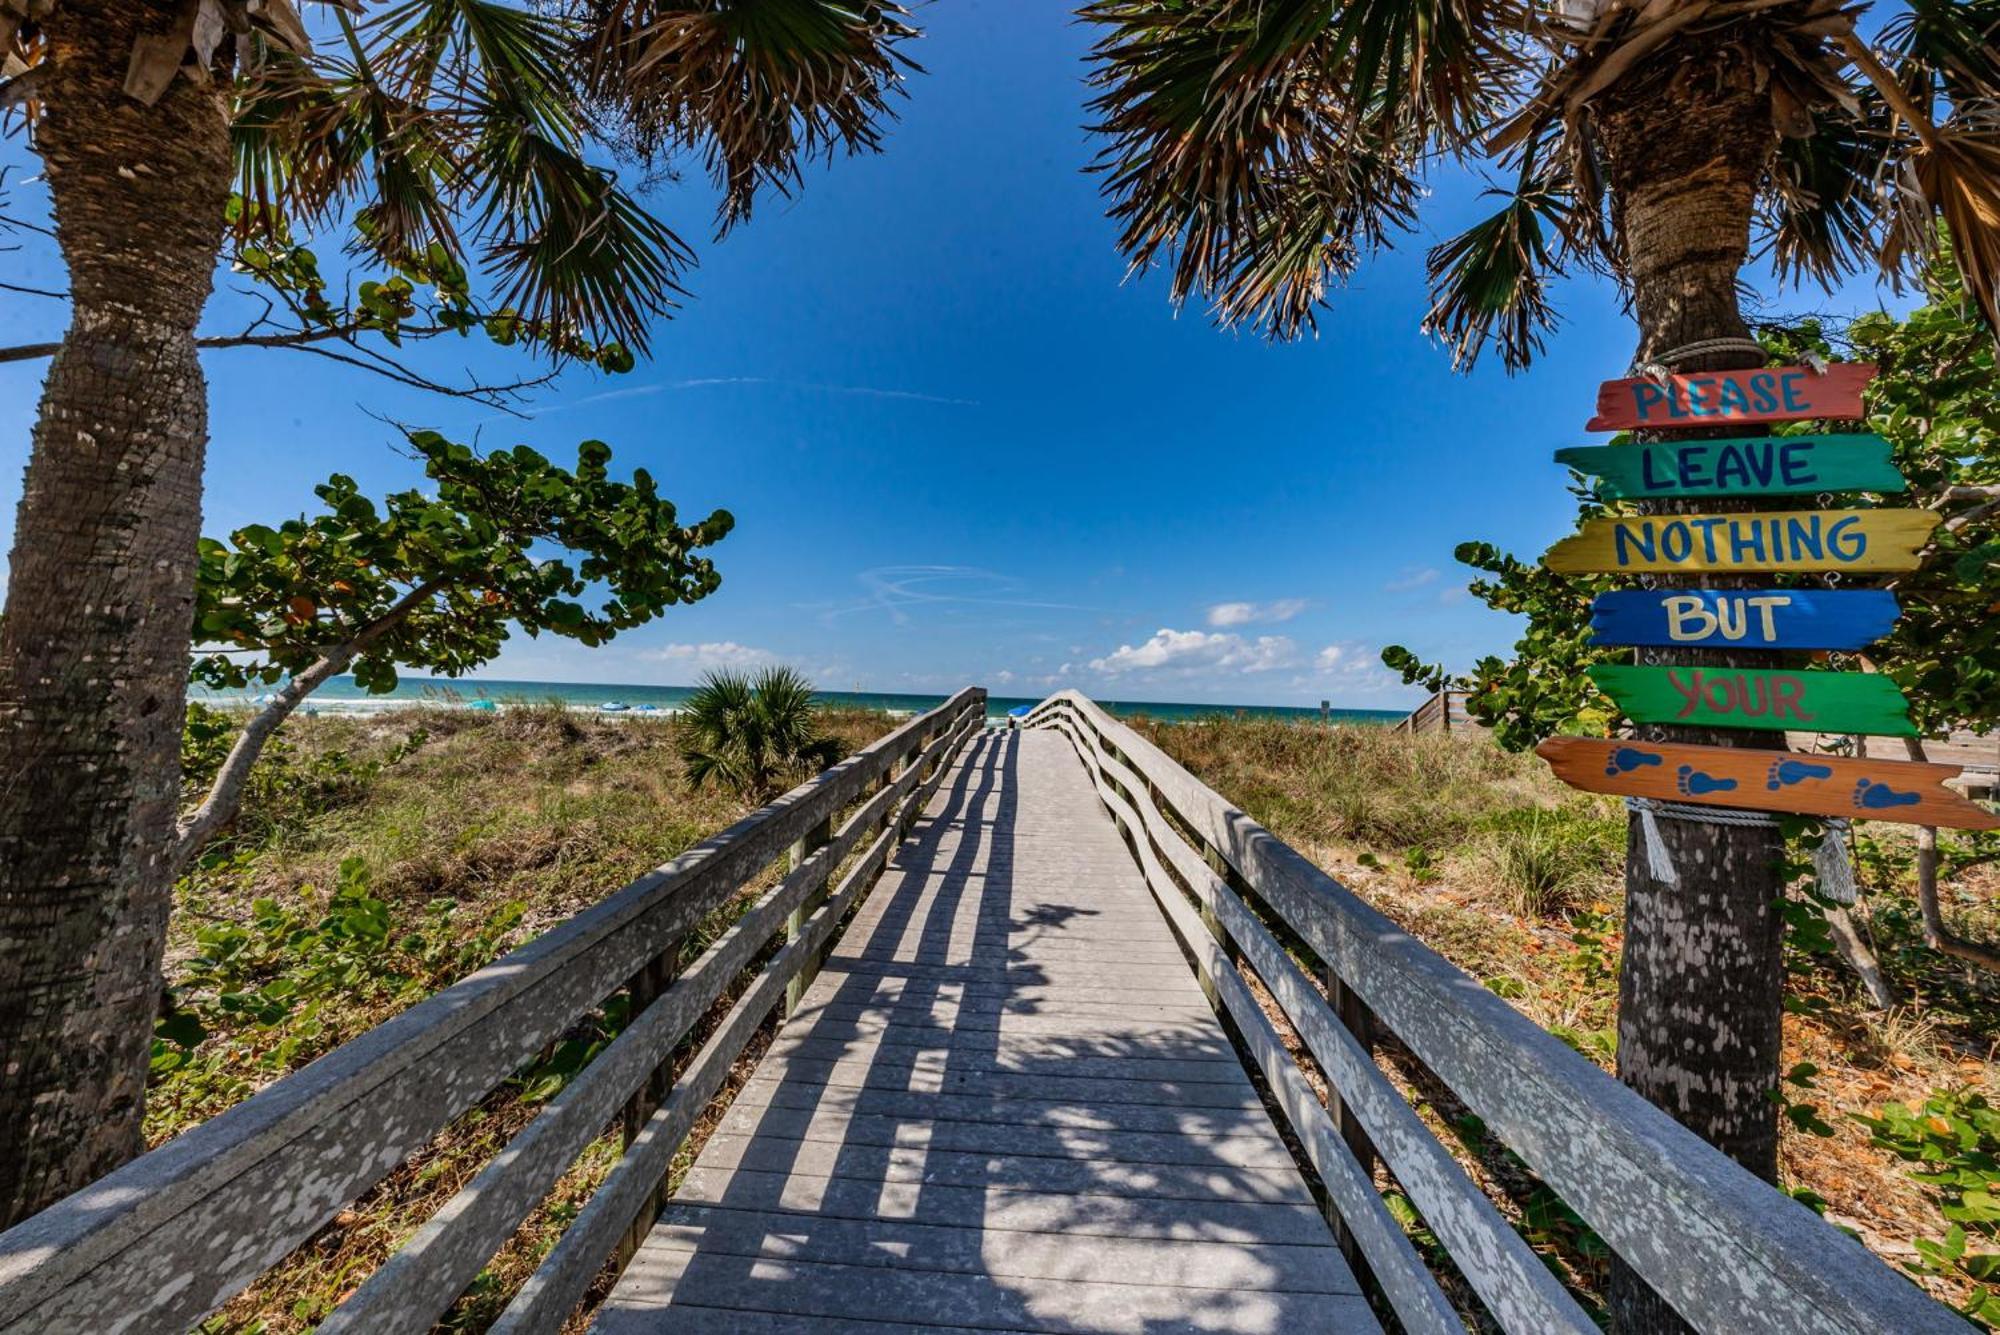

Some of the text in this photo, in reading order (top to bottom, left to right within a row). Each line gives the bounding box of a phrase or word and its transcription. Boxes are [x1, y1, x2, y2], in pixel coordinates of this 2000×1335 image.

[1632, 372, 1812, 421] PLEASE
[1642, 442, 1818, 490] LEAVE
[1614, 515, 1867, 566] NOTHING
[1662, 595, 1791, 641] BUT
[1669, 670, 1815, 721] YOUR
